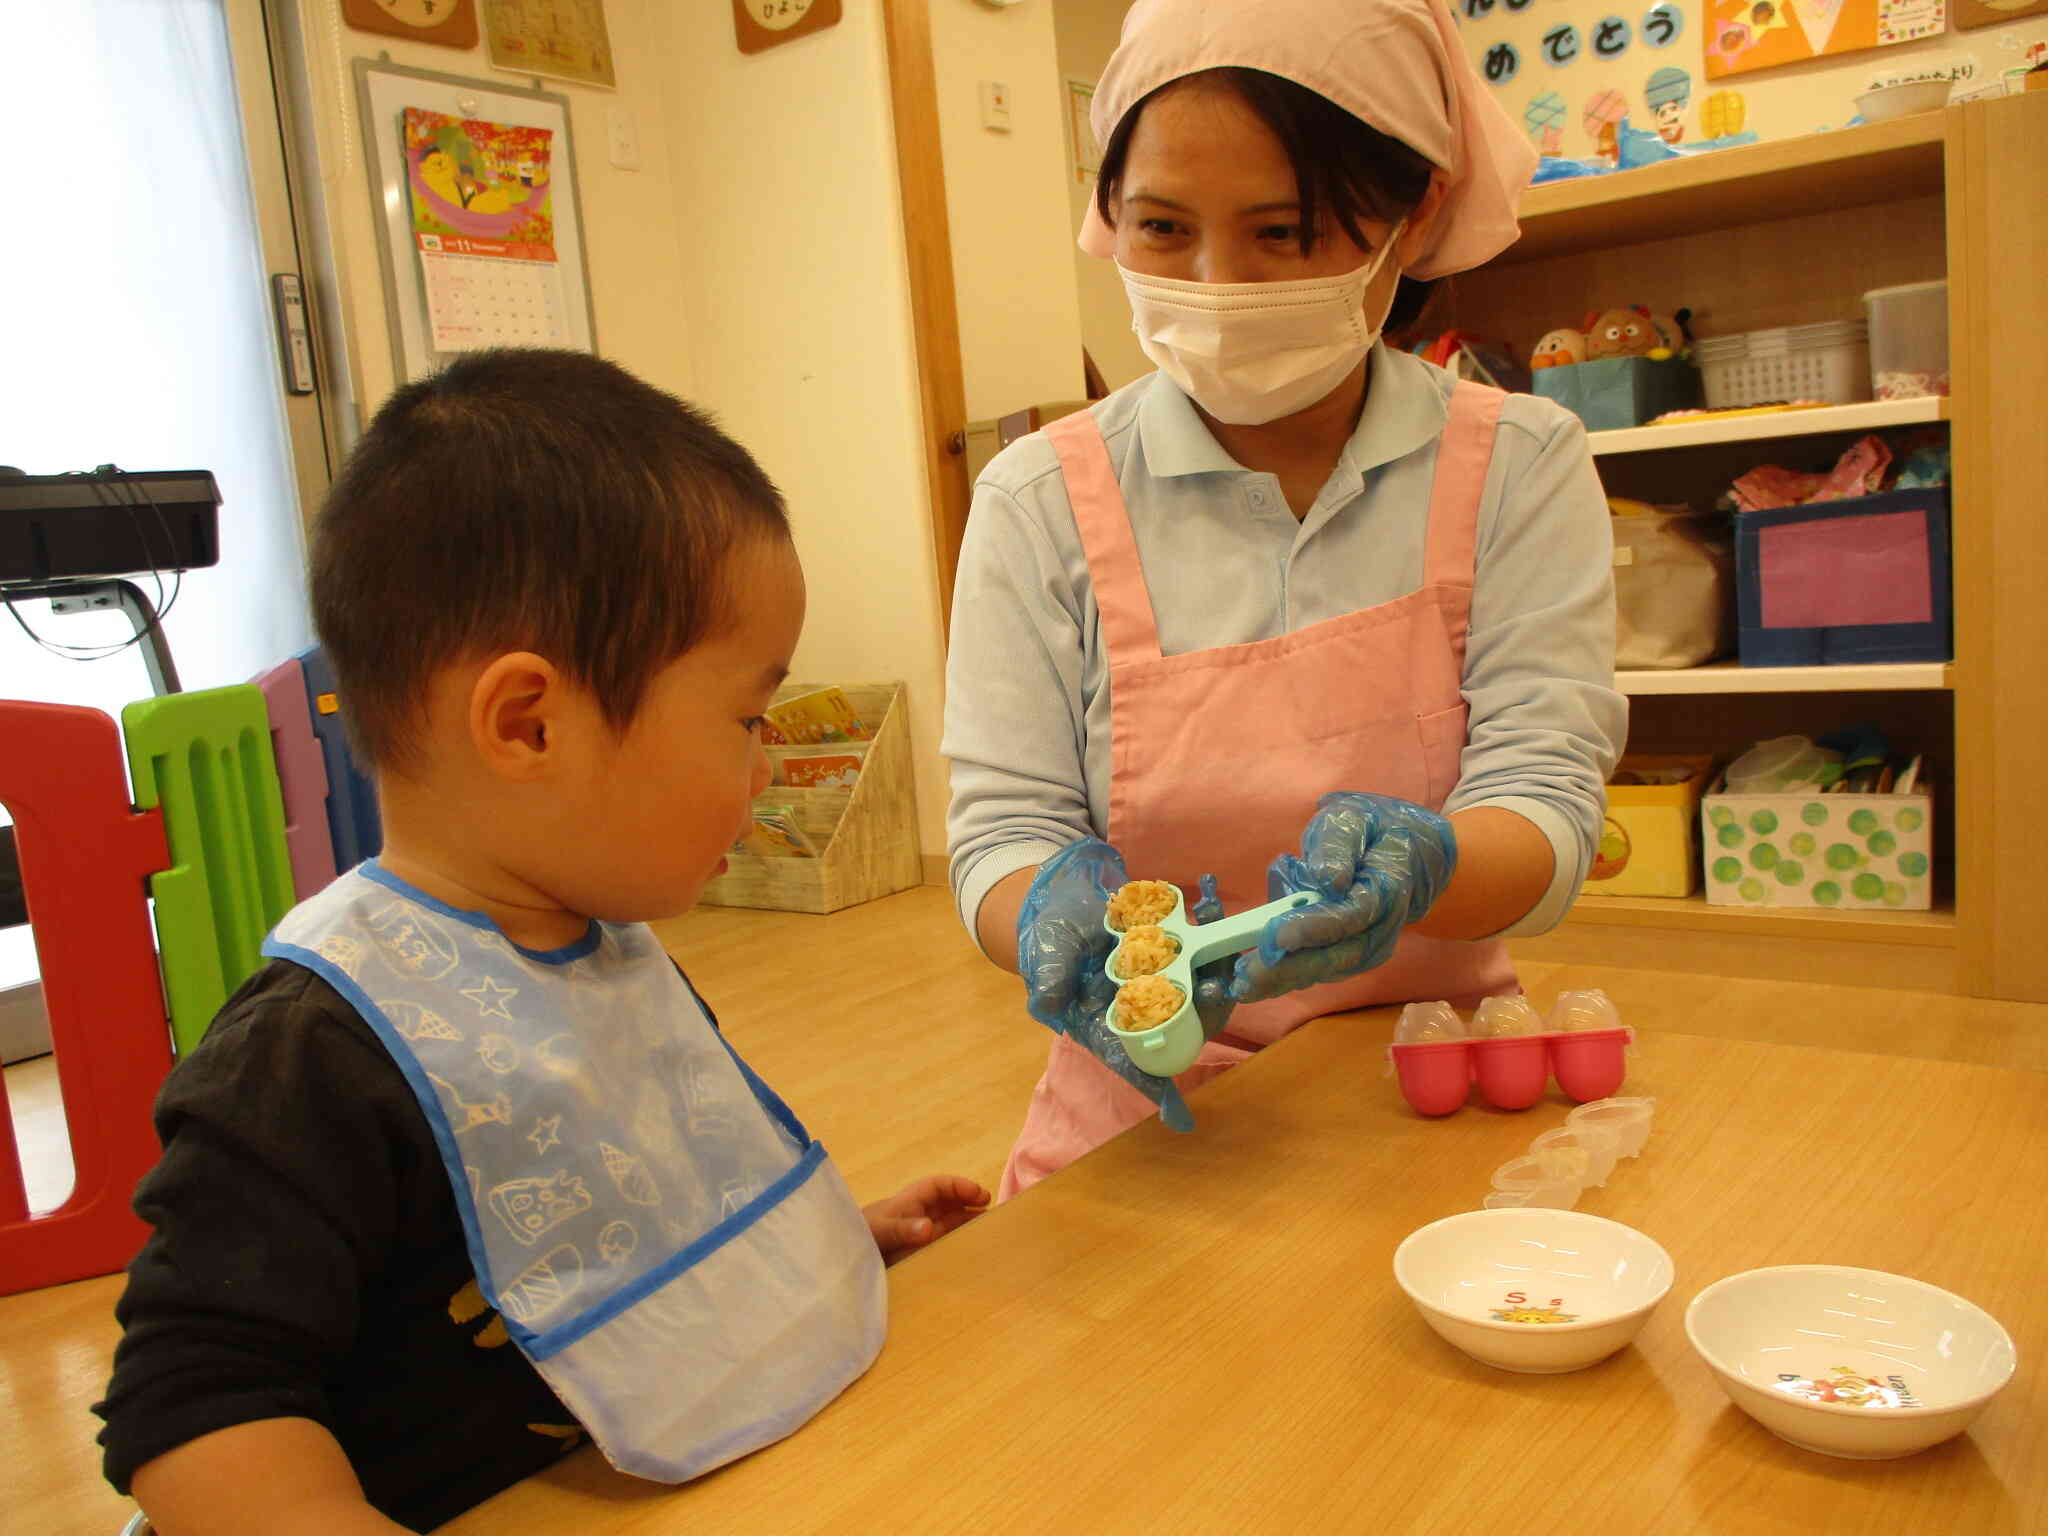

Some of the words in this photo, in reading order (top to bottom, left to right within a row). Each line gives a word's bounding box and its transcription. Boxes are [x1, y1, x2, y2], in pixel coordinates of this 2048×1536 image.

[1485, 11, 1675, 81] めでとう
[1503, 1291, 1527, 1304] S
